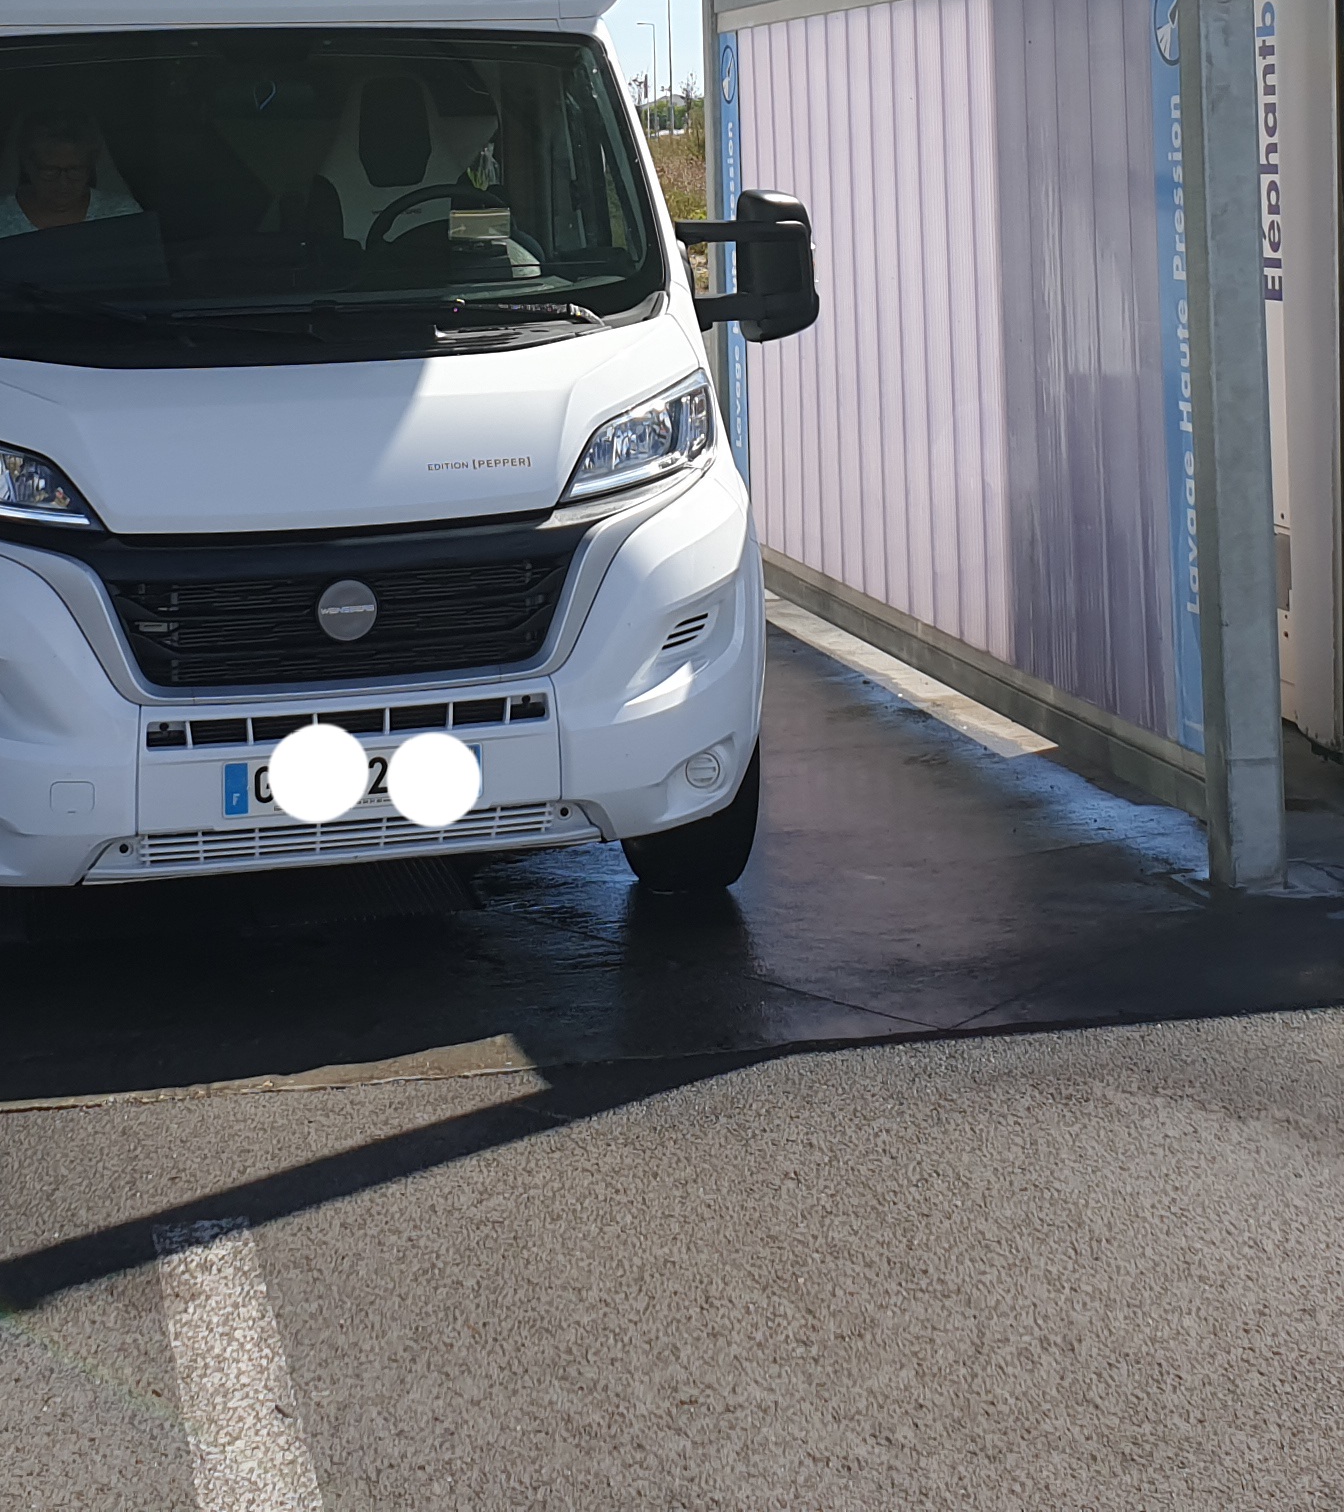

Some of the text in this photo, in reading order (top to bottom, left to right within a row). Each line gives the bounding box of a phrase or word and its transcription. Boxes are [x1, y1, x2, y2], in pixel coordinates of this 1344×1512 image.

[1168, 94, 1187, 280] Pression
[1178, 305, 1193, 432] Haute
[427, 456, 532, 471] EDITION [PEPPER]
[232, 793, 241, 806] F
